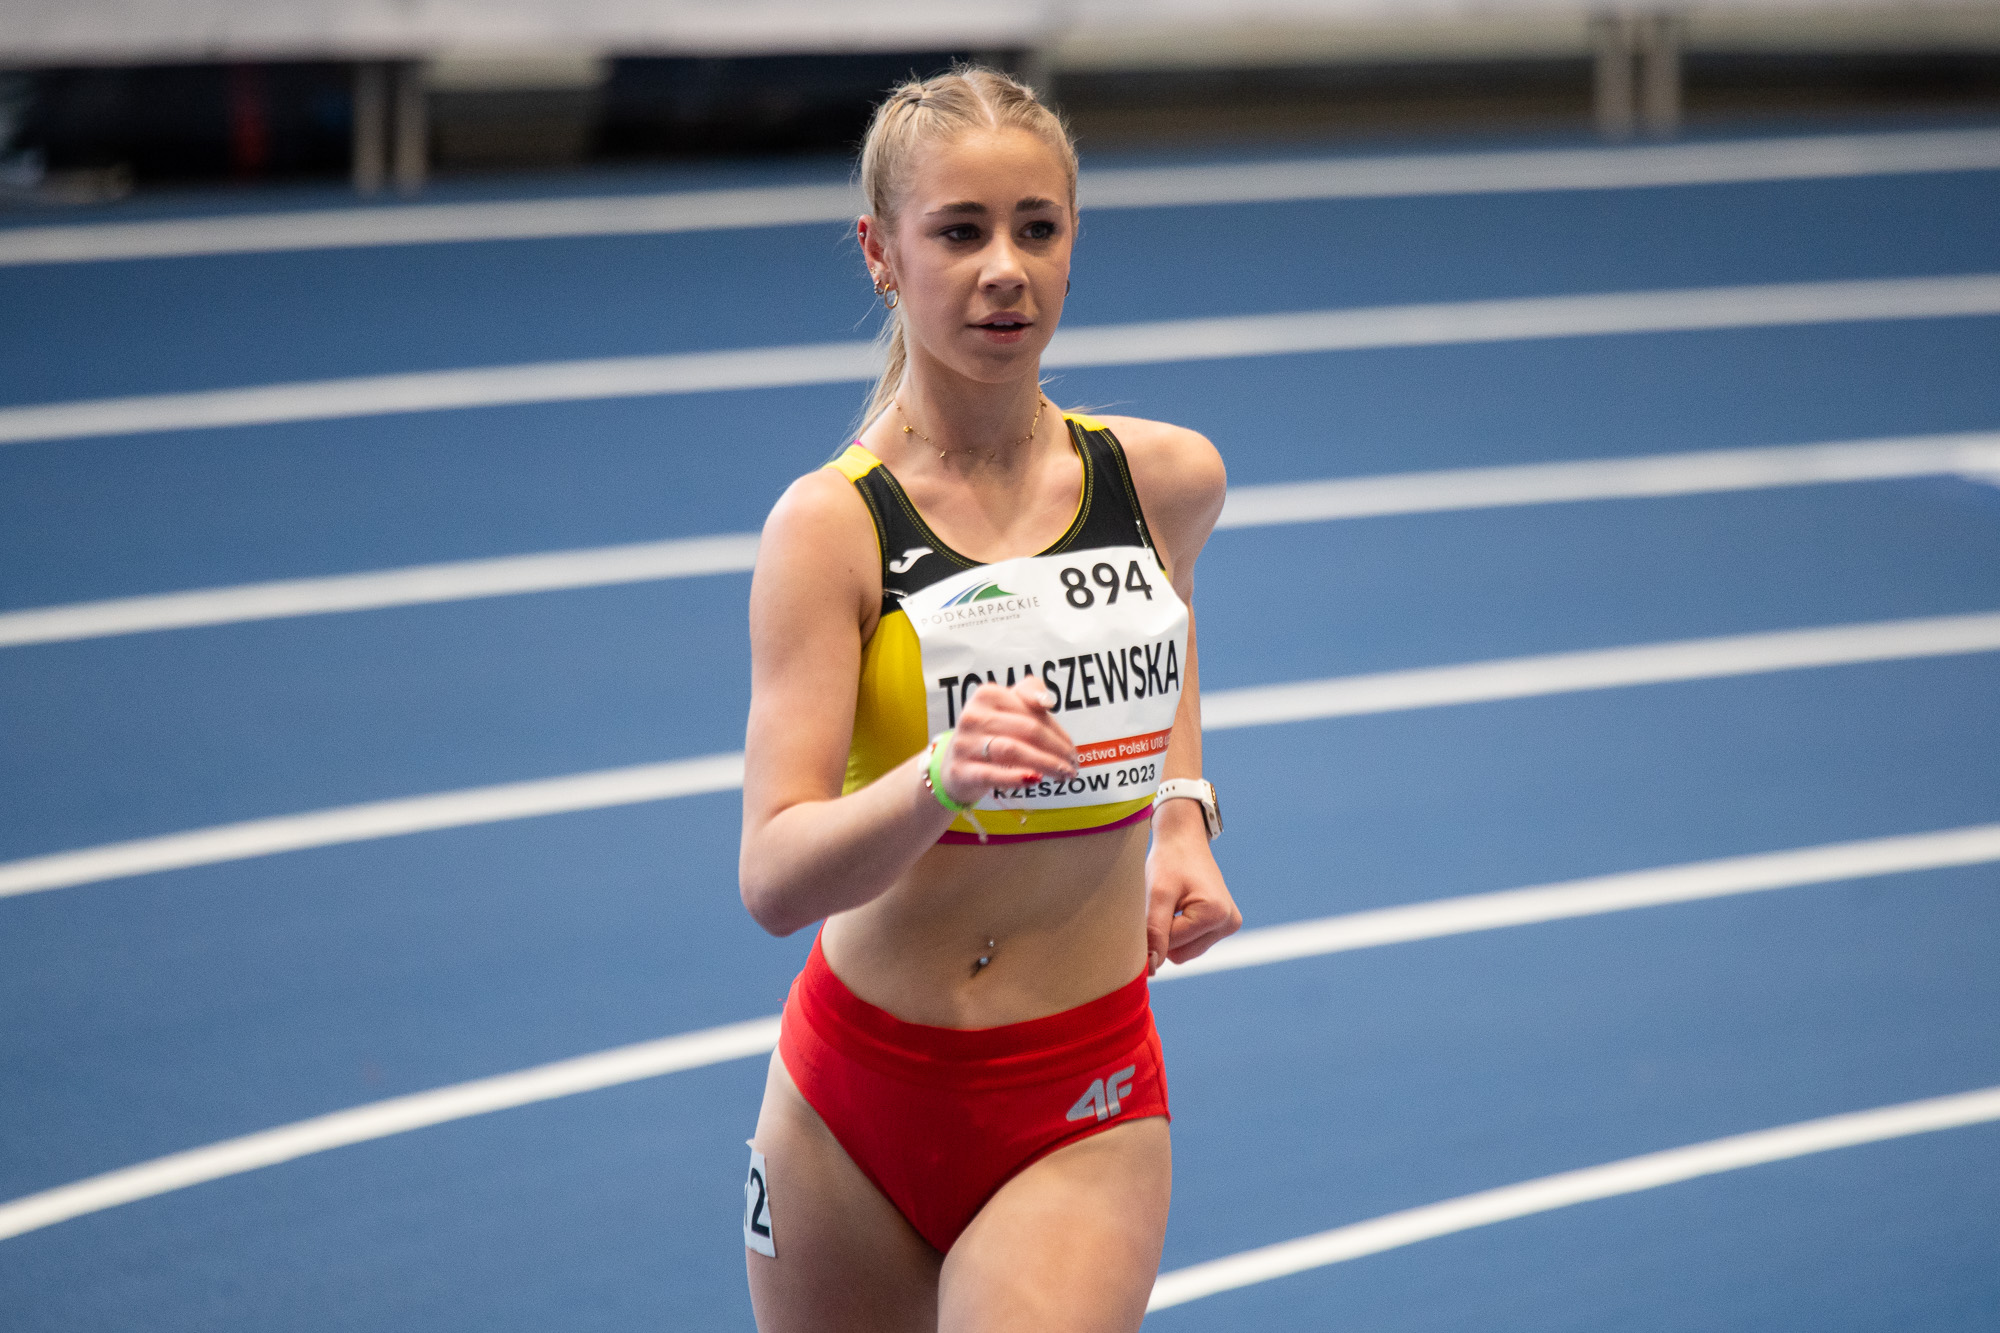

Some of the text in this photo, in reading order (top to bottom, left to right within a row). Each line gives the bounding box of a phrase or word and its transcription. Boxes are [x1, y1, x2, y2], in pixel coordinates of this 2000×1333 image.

[1060, 560, 1153, 610] 894
[921, 597, 1041, 627] PODKARPACKIE
[939, 640, 1180, 729] TOSZEWSKA
[1119, 739, 1150, 757] Polski
[1150, 736, 1164, 750] U18
[1117, 763, 1156, 788] 2023
[1066, 1064, 1136, 1122] 4F
